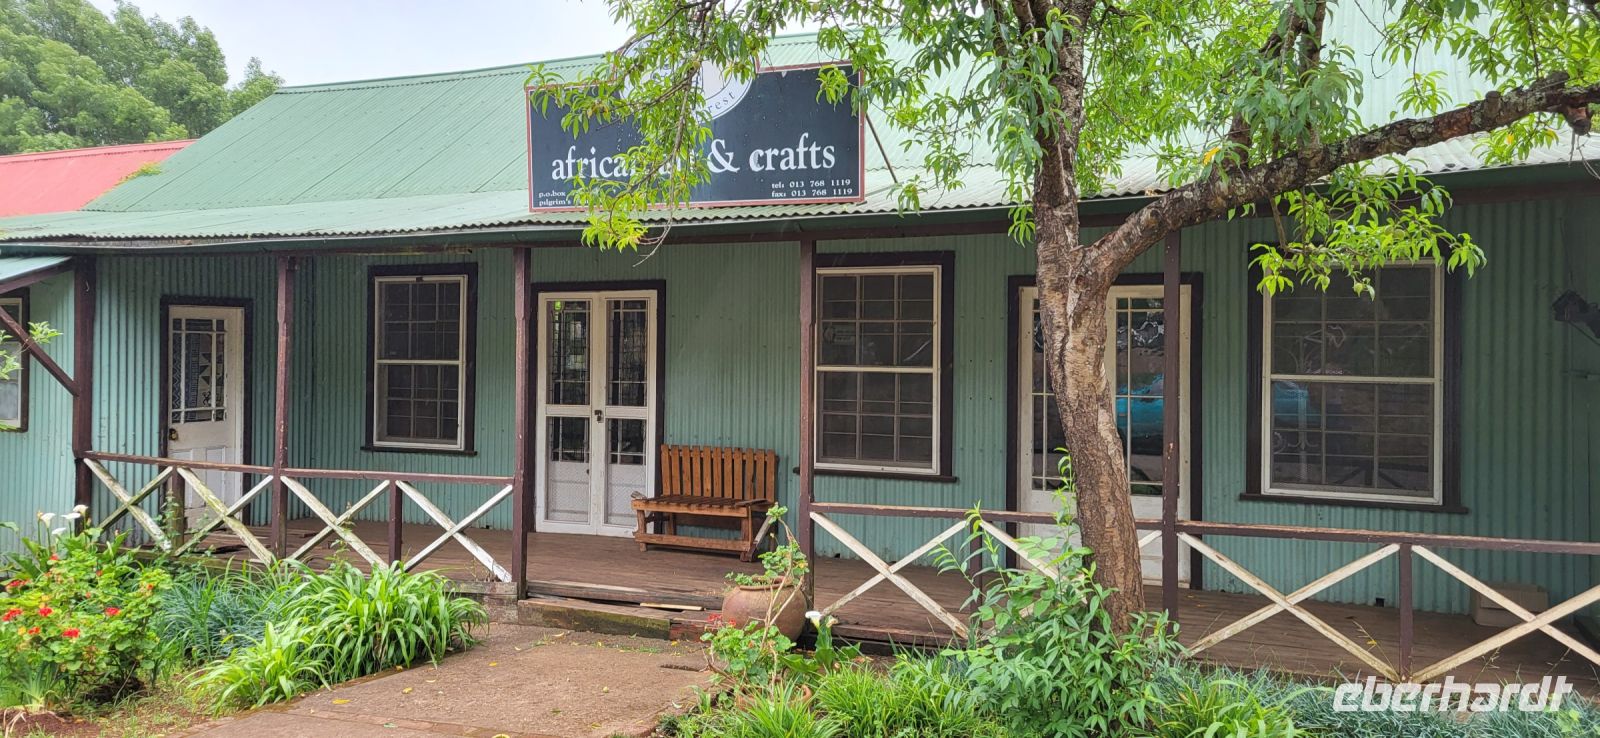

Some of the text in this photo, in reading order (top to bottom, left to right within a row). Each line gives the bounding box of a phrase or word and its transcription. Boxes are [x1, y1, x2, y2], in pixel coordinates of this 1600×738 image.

[707, 138, 740, 173] &
[749, 132, 836, 172] crafts
[771, 181, 784, 189] tel:
[831, 179, 851, 187] 1119
[771, 190, 786, 198] fax:
[833, 188, 853, 196] 1119
